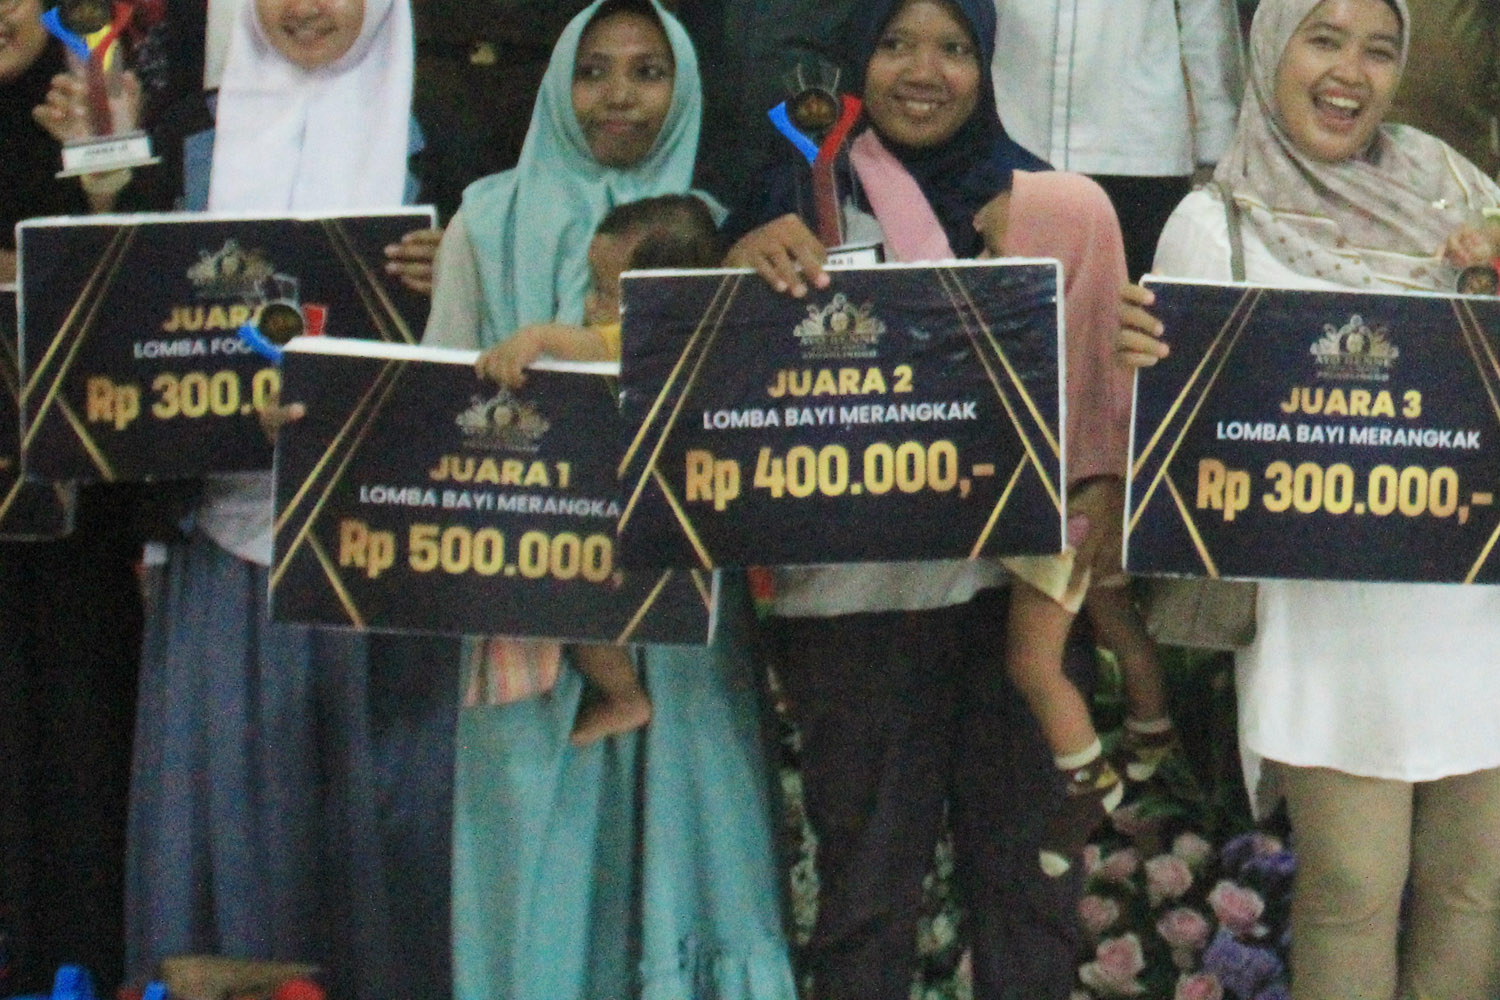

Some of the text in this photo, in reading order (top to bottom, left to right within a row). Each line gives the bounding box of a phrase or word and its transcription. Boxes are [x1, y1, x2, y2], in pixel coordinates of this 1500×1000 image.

[162, 304, 263, 332] JUAR
[133, 338, 206, 360] LOMBA
[767, 364, 914, 399] JUARA 2
[86, 375, 141, 431] Rp
[702, 401, 978, 430] LOMBA BAYI MERANGKAK
[1280, 387, 1423, 419] JUARA 3
[1216, 421, 1481, 450] LOMBA BAYI MERANGKAK
[429, 453, 571, 488] JUARA 1
[685, 439, 996, 512] Rp 400.000,-
[359, 485, 621, 518] LOMBA BAYI MERANGKA
[1196, 457, 1494, 525] Rp 300.000,-
[338, 521, 395, 579] Rp
